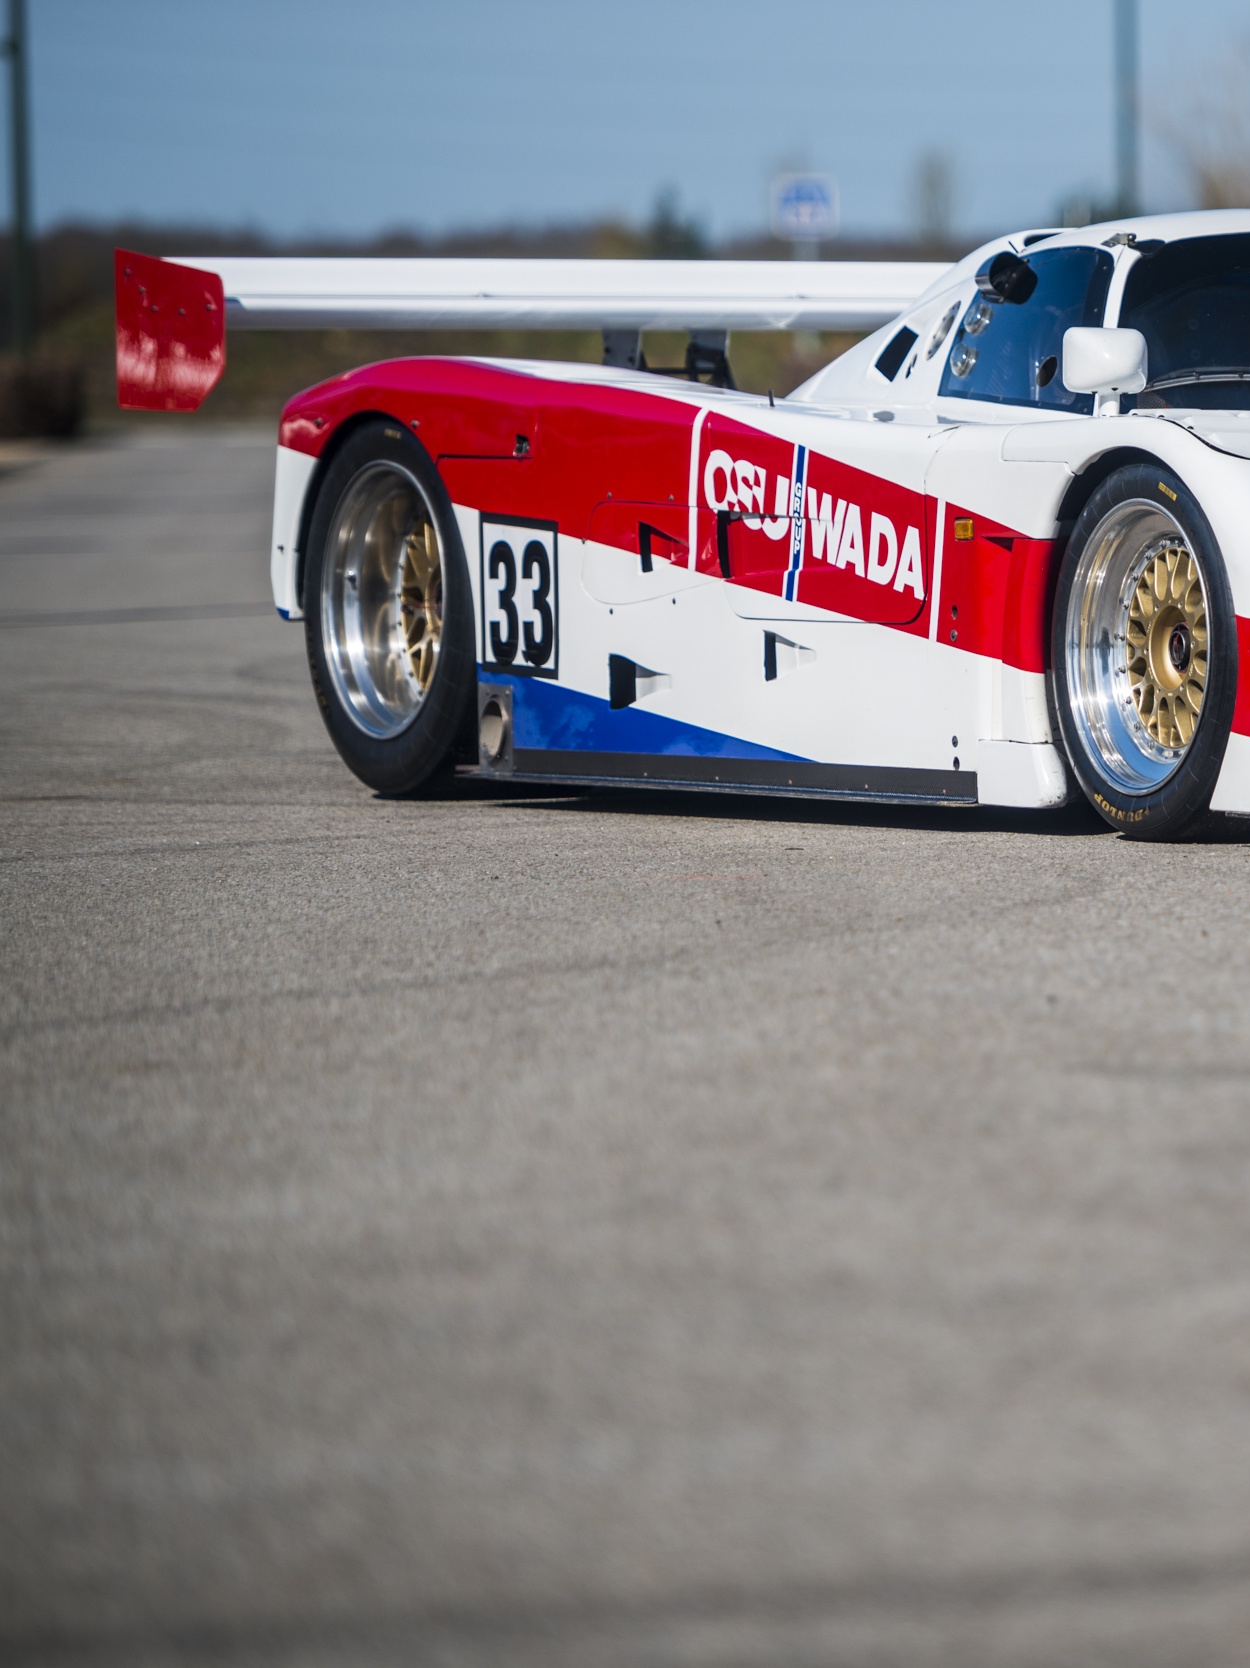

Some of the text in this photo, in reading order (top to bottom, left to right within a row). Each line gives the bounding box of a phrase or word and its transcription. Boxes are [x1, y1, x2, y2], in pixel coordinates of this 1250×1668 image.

[704, 449, 925, 601] OSU WADA
[793, 481, 802, 555] GROUP
[488, 540, 553, 668] 33
[1093, 793, 1144, 822] DUNLOP
